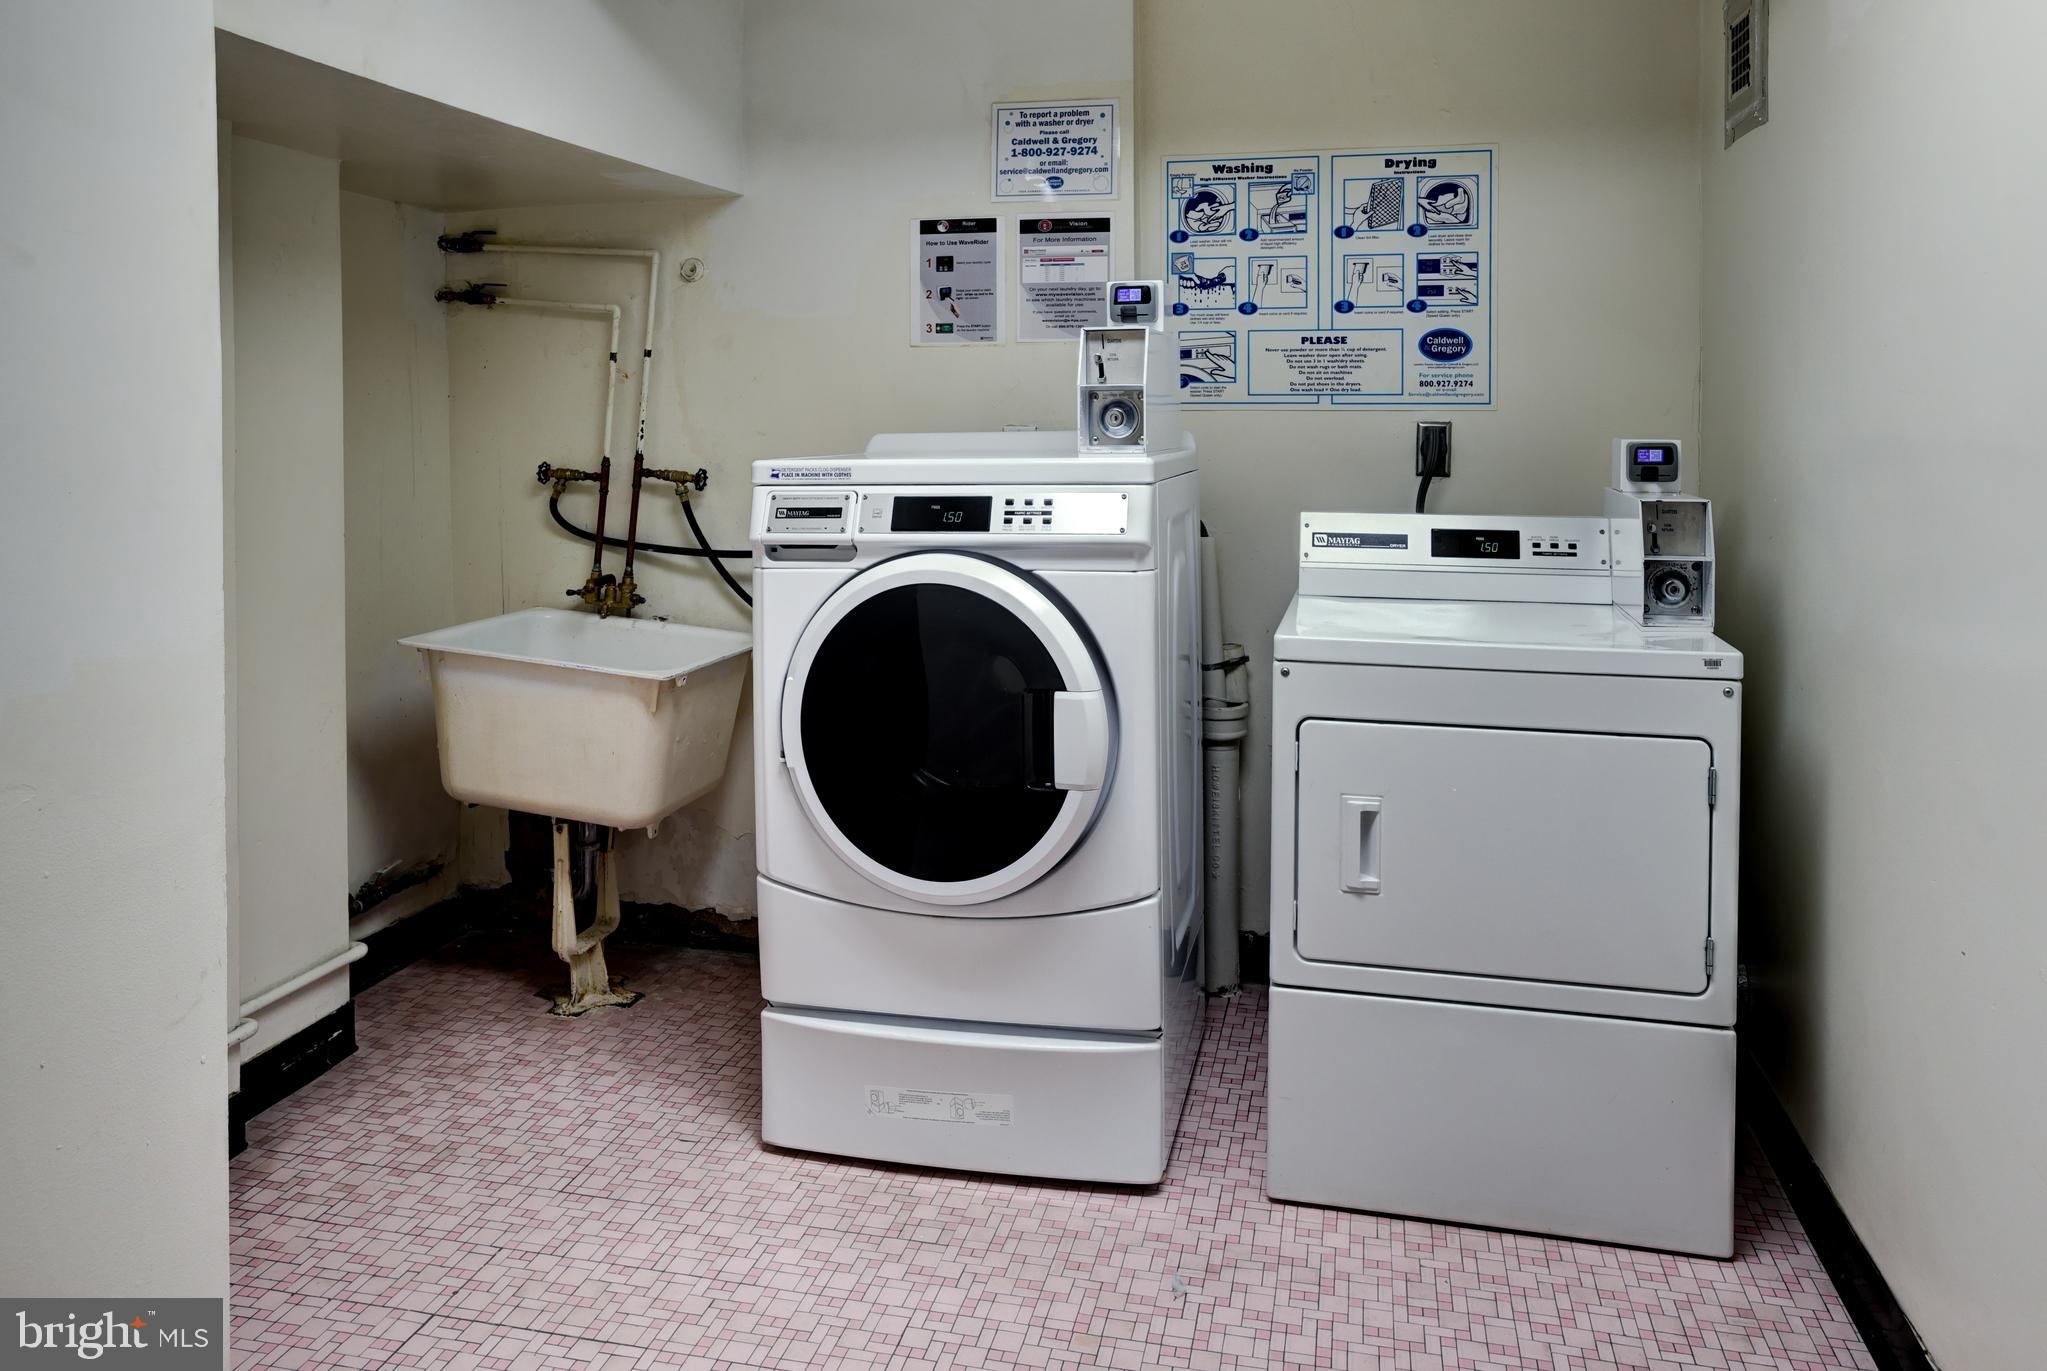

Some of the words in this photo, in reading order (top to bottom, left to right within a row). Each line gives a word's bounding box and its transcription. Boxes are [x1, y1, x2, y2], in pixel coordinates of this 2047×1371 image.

[1060, 110, 1090, 118] problem
[1076, 118, 1094, 126] dryer
[1012, 138, 1049, 146] Caldwell
[1062, 137, 1097, 145] Gregory
[1011, 147, 1098, 157] 1-800-927-9274
[1385, 157, 1437, 169] Drying
[1000, 167, 1108, 175] service@caldwellandgregory.com
[1212, 163, 1273, 174] Washing
[926, 258, 932, 268] 1
[926, 290, 932, 299] 2
[926, 324, 932, 333] 3
[1301, 336, 1347, 344] PLEASE
[1431, 345, 1466, 354] Gregory
[942, 512, 962, 523] 1.50
[1480, 543, 1498, 553] 1.50
